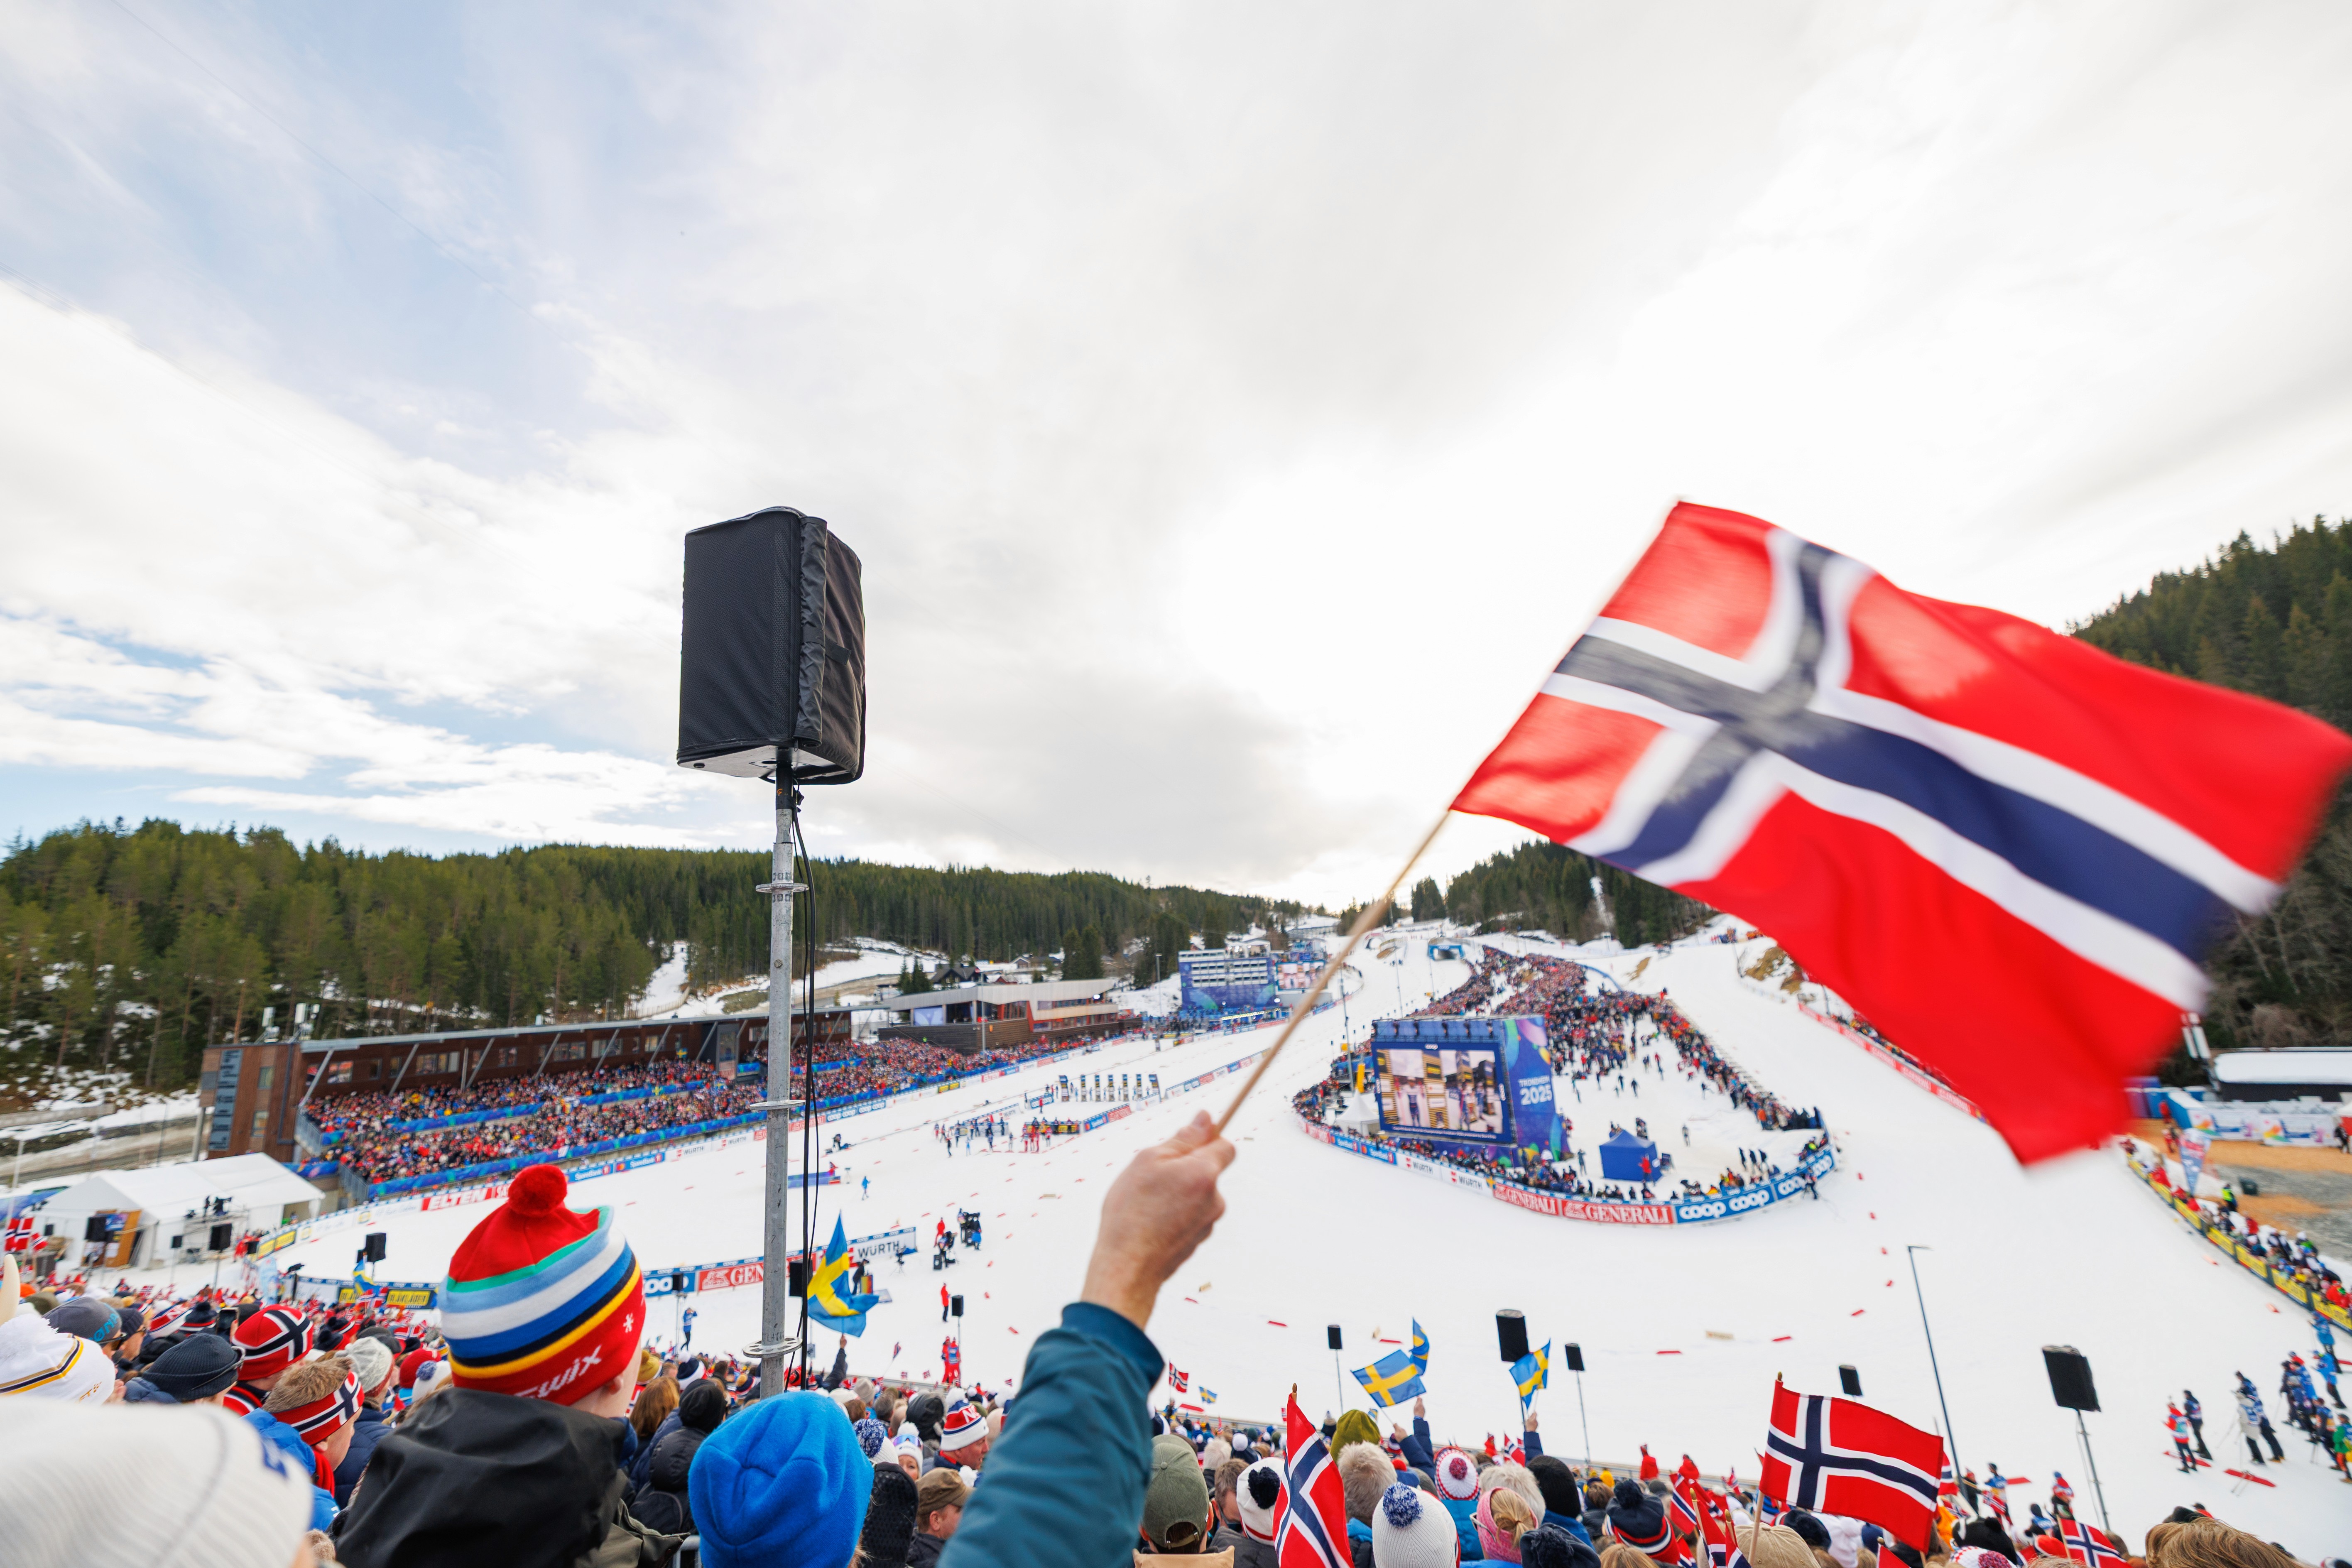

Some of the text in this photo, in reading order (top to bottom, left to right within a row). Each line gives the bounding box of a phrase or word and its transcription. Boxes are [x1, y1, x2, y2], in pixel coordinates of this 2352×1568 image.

[1519, 1075, 1551, 1087] TRONDHEIM
[1519, 1083, 1553, 1105] 2025
[1459, 1176, 1483, 1190] WÜRTH
[430, 1188, 486, 1211] ELTEN
[1507, 1189, 1556, 1214] GENERALI
[1679, 1189, 1770, 1220] coop coop
[1585, 1204, 1671, 1223] GENERALI
[858, 1241, 899, 1257] WÜRTH
